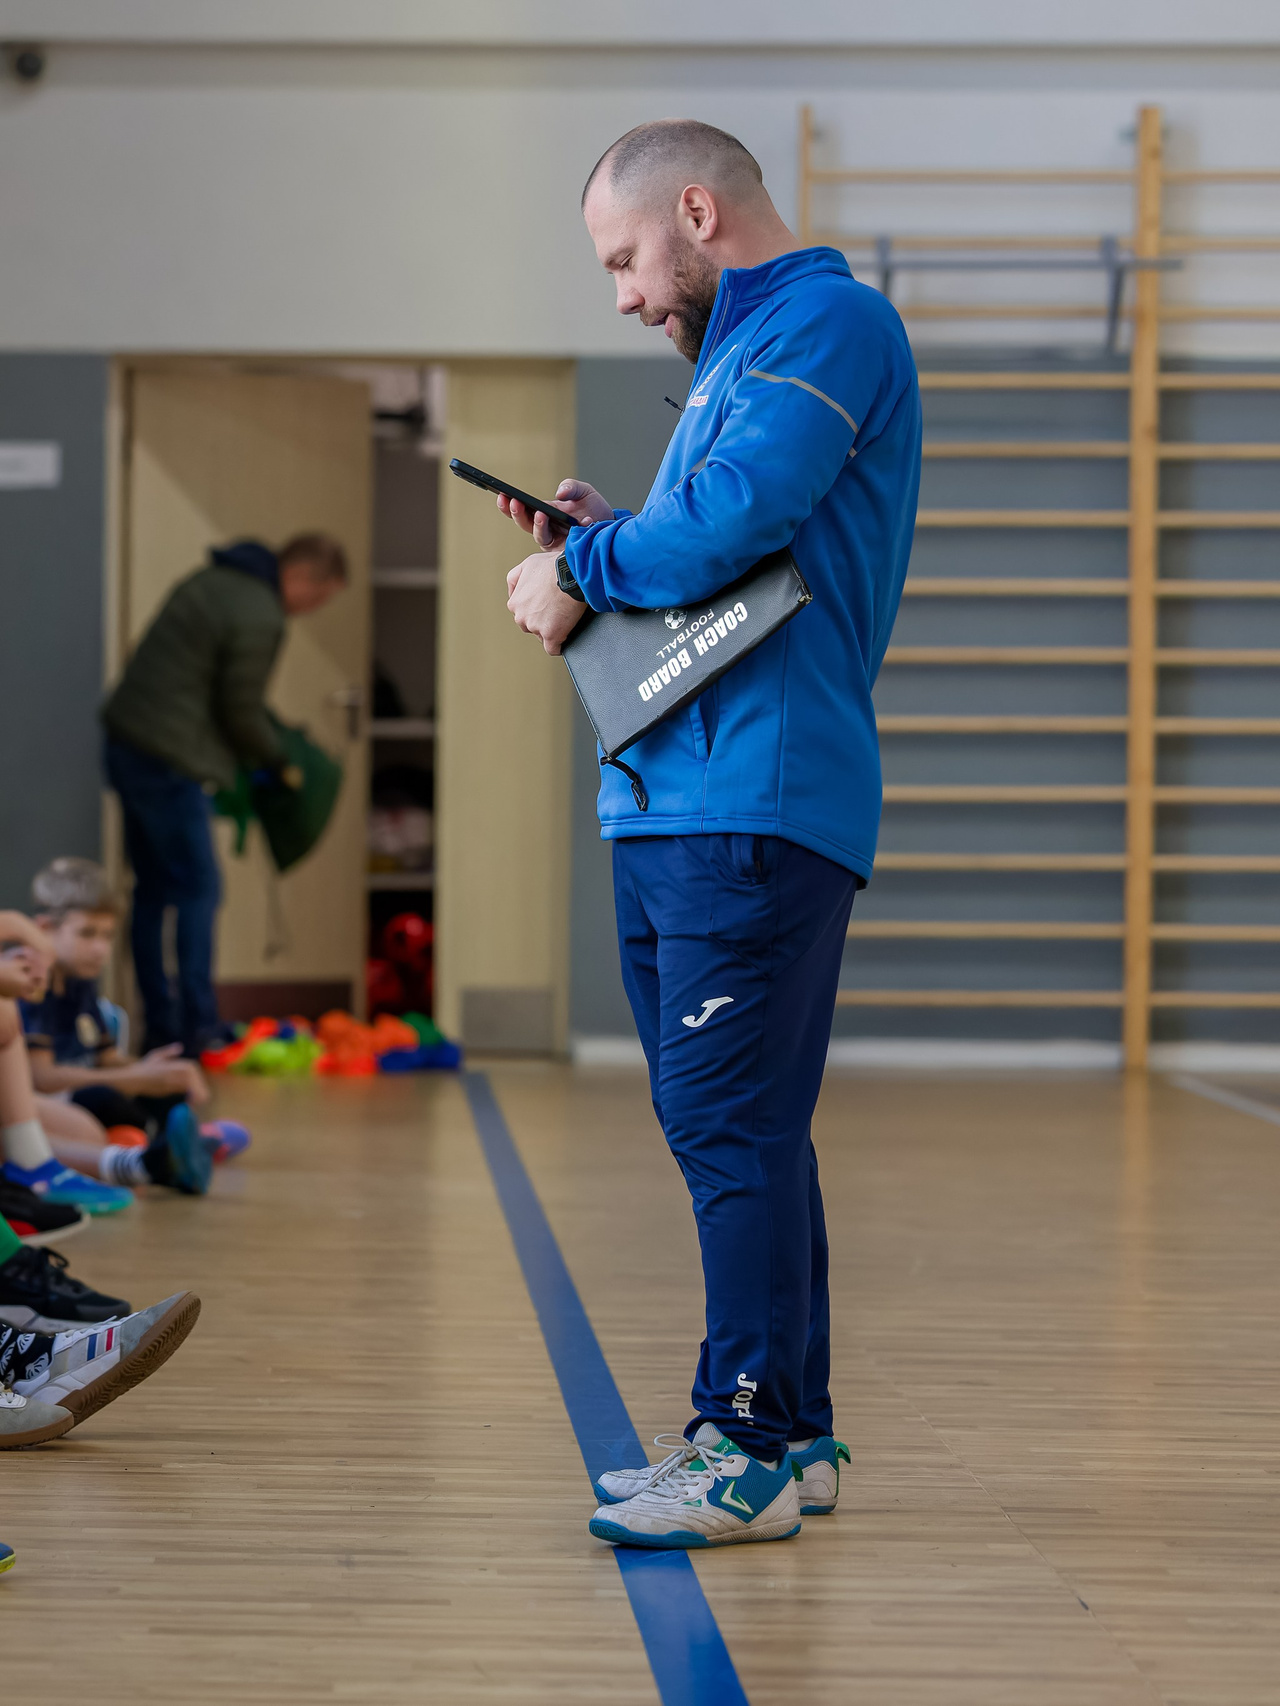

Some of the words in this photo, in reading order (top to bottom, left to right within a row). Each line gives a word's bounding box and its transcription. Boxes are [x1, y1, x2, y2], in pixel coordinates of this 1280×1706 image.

[656, 608, 715, 659] FOOTBALL
[693, 602, 748, 656] COACH
[638, 648, 693, 702] BOARD
